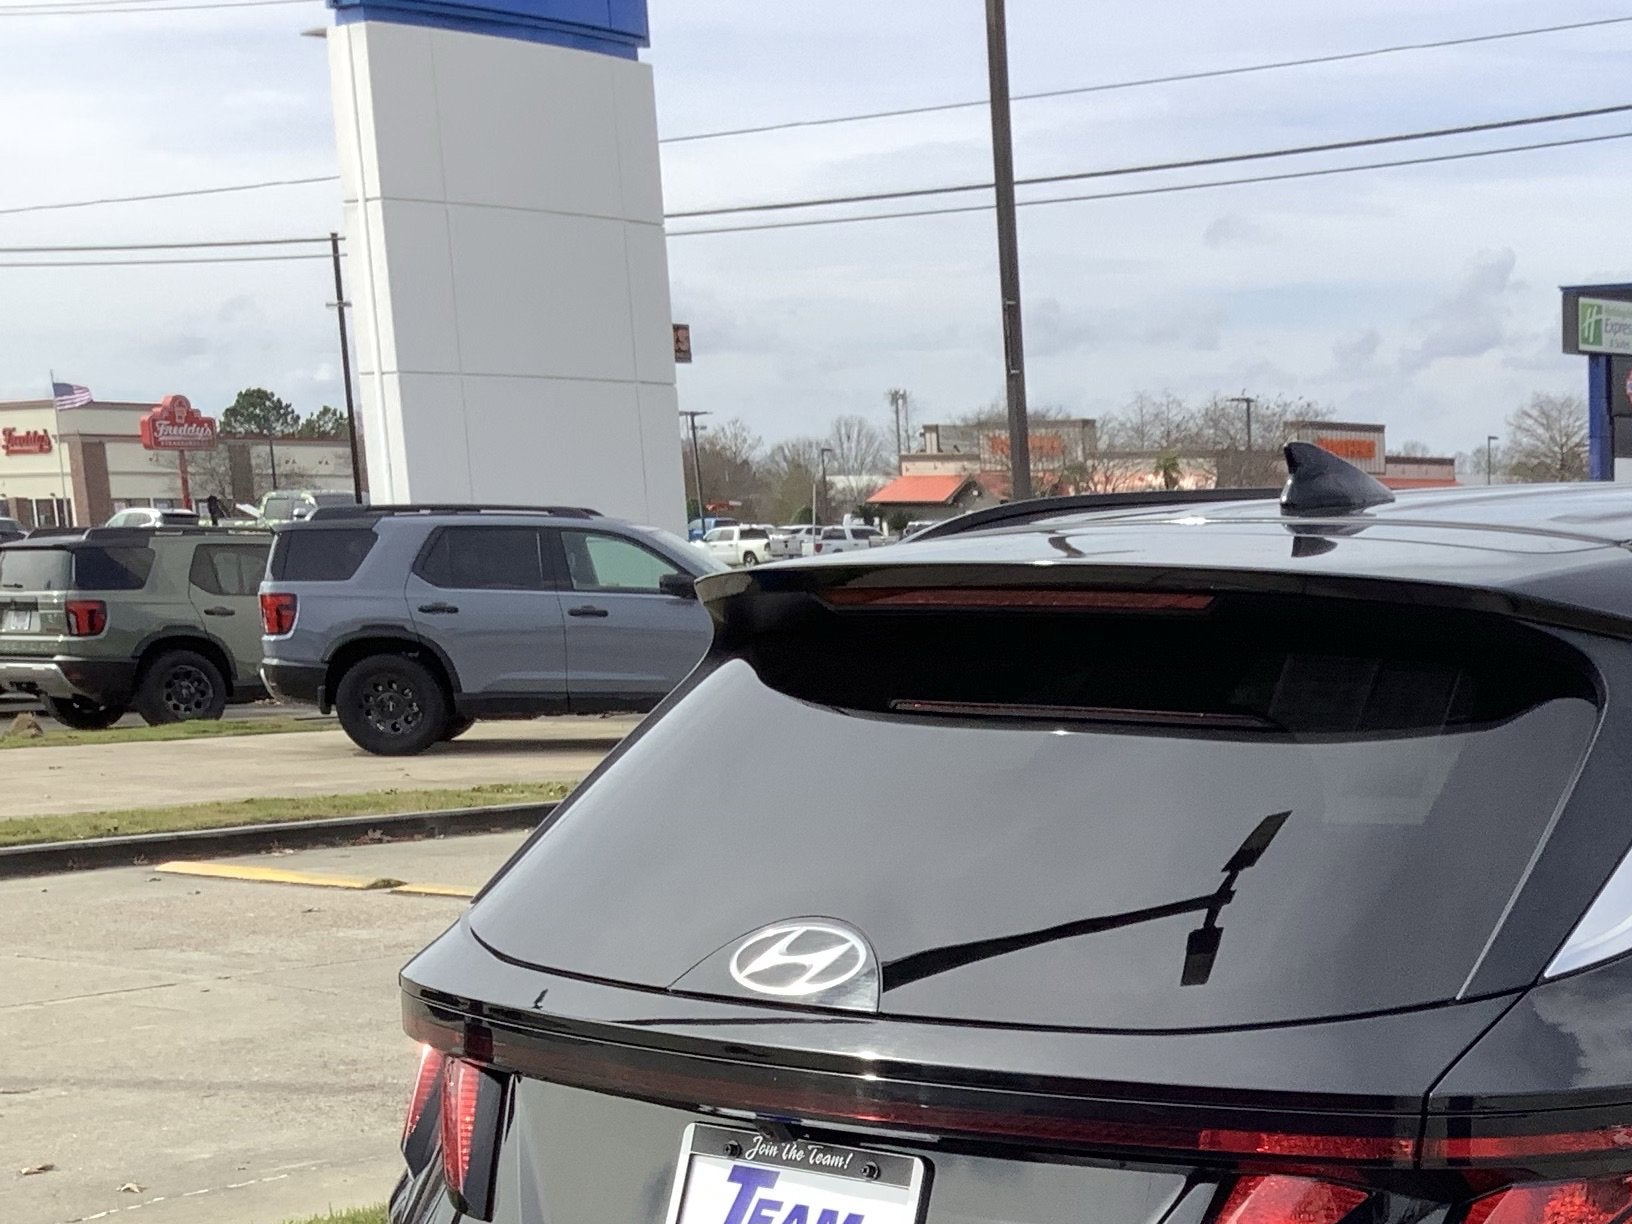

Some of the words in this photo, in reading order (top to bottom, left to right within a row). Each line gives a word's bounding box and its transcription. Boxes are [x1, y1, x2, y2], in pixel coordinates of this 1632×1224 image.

[154, 420, 213, 439] Freddy's
[744, 1136, 778, 1160] Join
[806, 1144, 854, 1169] Team!
